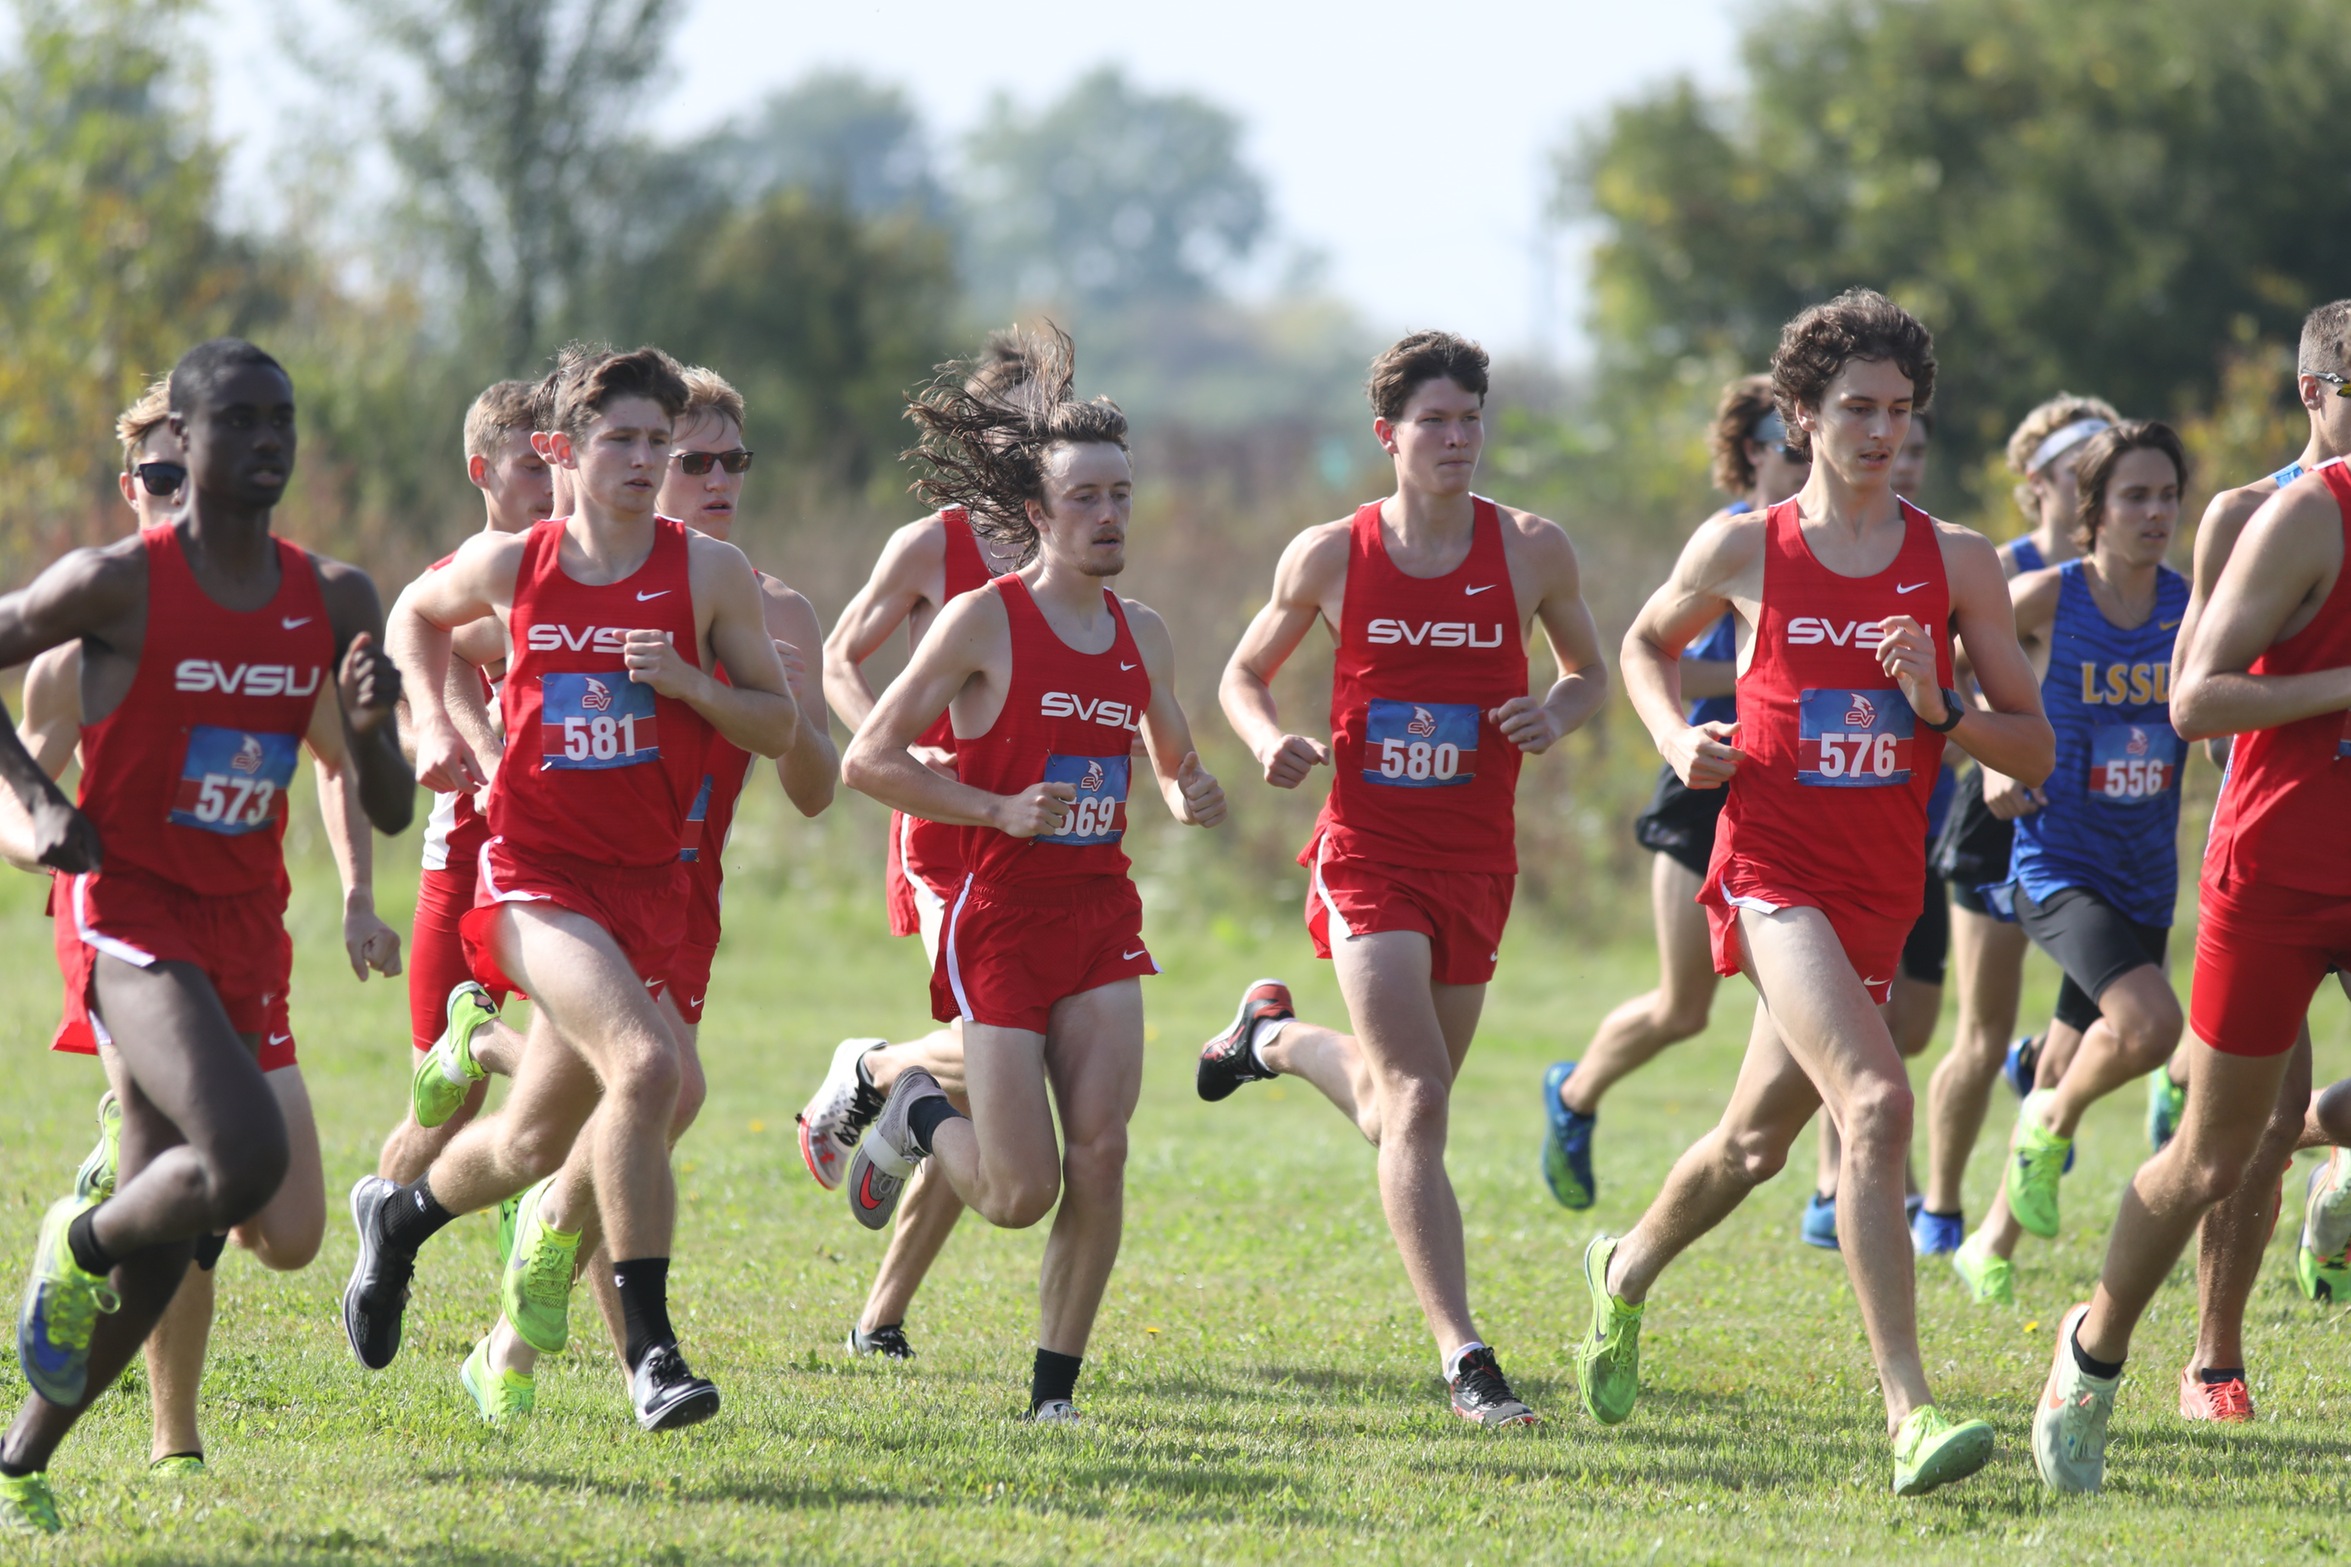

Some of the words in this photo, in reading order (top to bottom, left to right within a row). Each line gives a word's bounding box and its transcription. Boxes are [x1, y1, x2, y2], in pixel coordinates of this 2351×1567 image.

[527, 624, 674, 654] SVS
[1367, 618, 1503, 648] SVSU
[1788, 617, 1931, 649] SVS
[175, 658, 321, 696] SVSU
[1041, 691, 1144, 732] SVSU
[564, 713, 636, 762] 581
[1819, 732, 1897, 778] 576
[1380, 738, 1459, 781] 580
[2104, 759, 2164, 798] 556
[194, 772, 275, 827] 573
